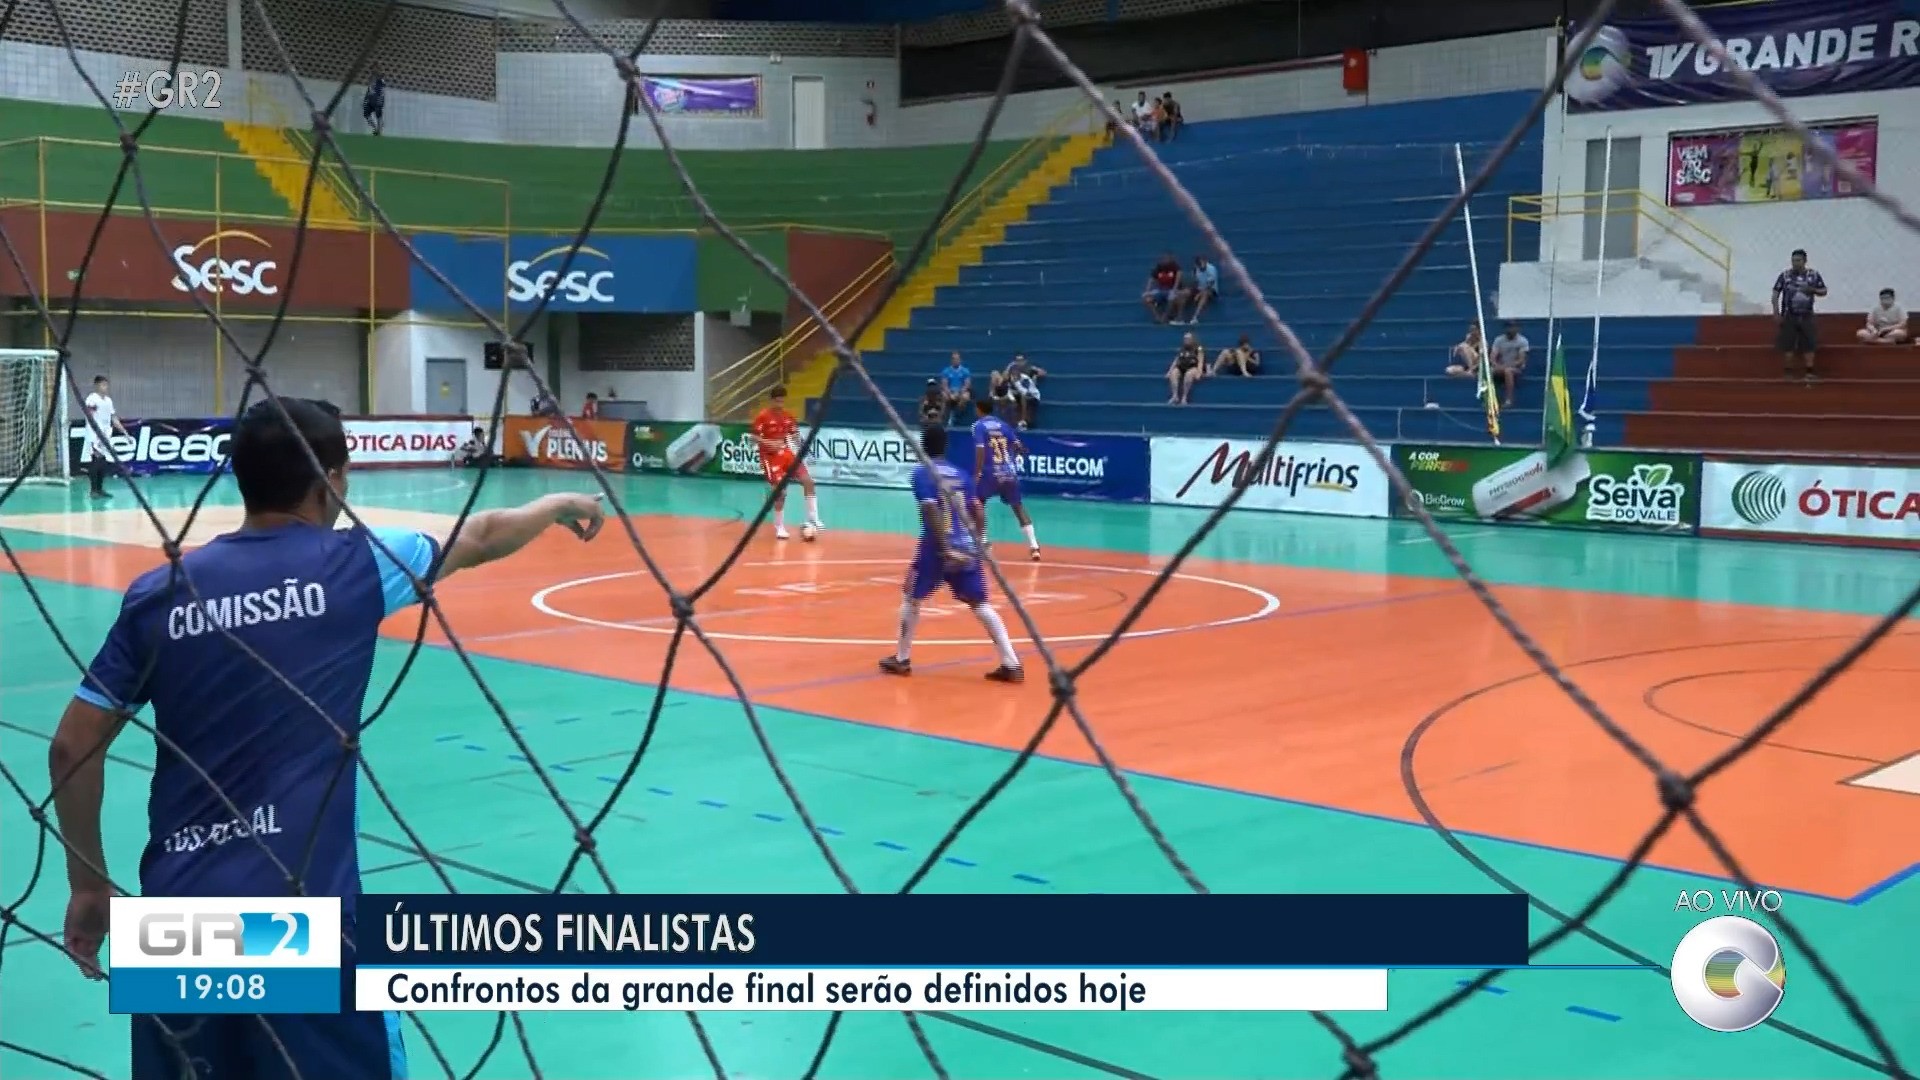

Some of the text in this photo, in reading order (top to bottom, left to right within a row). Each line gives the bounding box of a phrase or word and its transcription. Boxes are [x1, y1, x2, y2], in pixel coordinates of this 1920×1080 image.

[1646, 43, 1694, 80] TV
[1694, 24, 1878, 76] GRANDE
[1677, 145, 1708, 160] VEM
[1676, 169, 1711, 185] SESC
[171, 245, 278, 294] Sesc
[410, 434, 456, 451] DIAS
[1029, 455, 1104, 477] TELECOM
[1176, 442, 1360, 498] Multifrios
[1592, 477, 1677, 509] Seiva
[1798, 480, 1920, 521] ÓTICA
[1615, 508, 1676, 521] DO VALE
[168, 578, 326, 640] COMISSÃO
